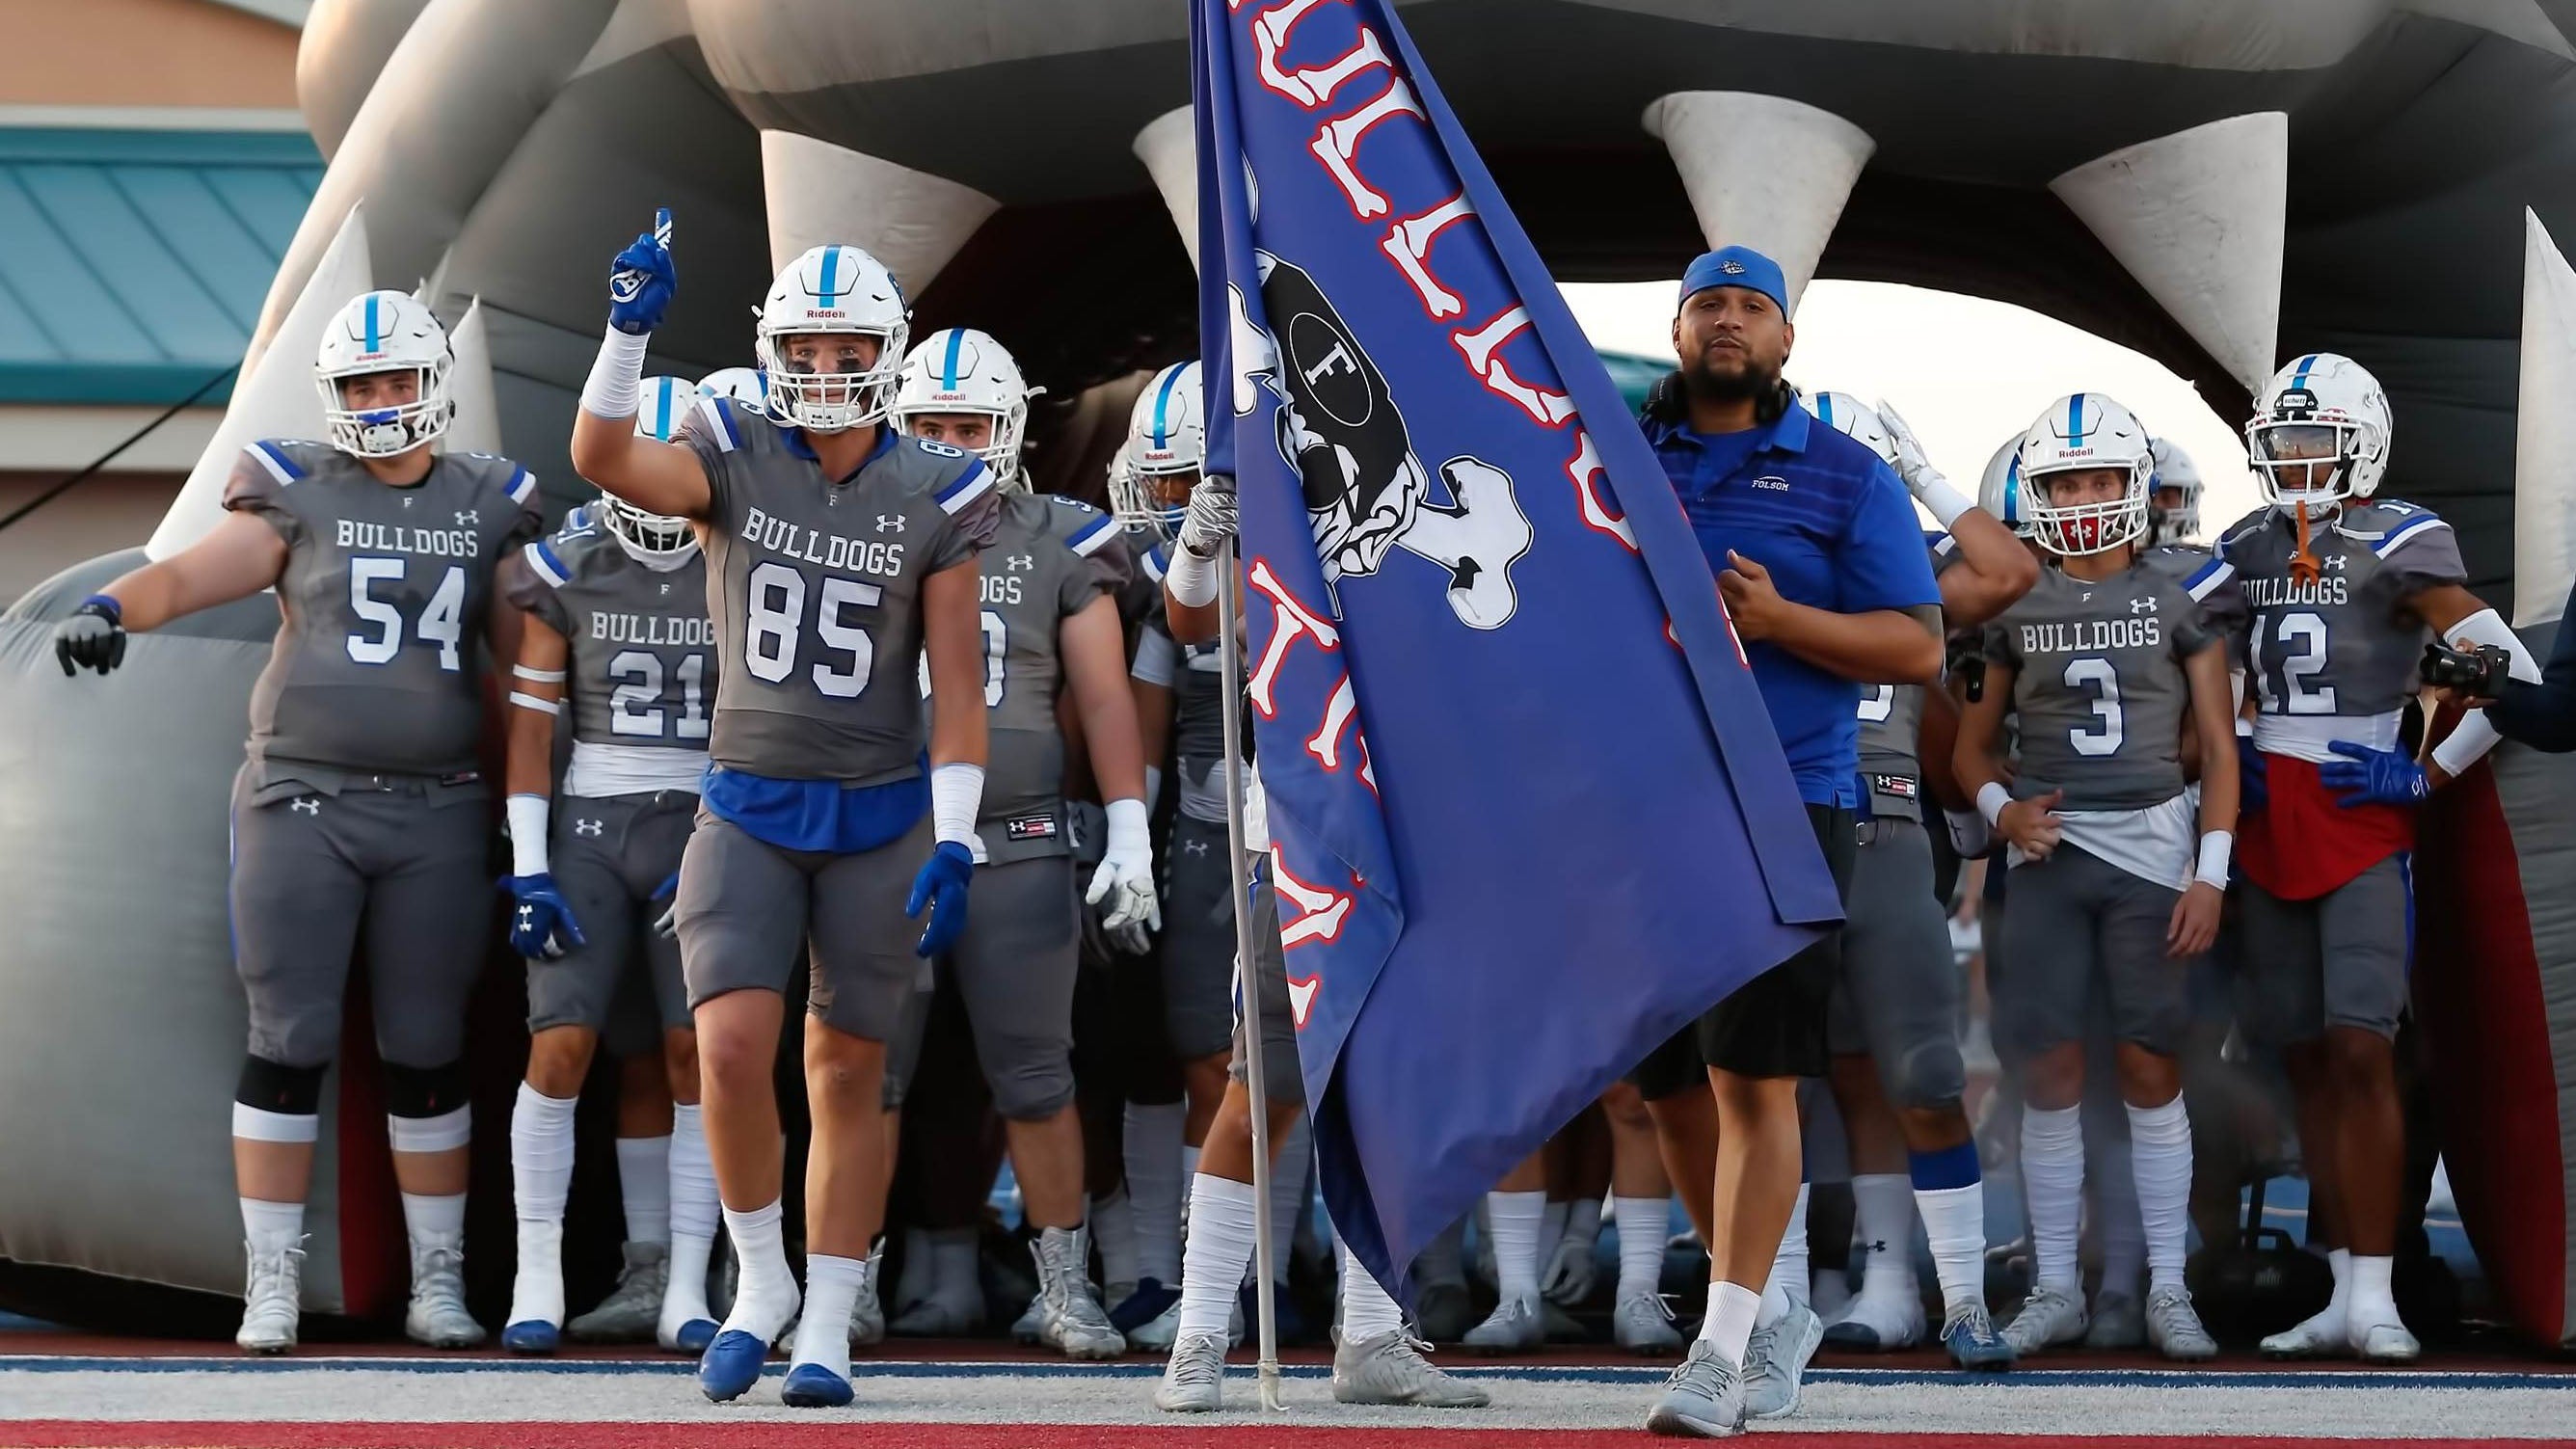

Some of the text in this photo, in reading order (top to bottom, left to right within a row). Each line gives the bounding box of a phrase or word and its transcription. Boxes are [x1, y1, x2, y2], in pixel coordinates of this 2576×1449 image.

[1304, 340, 1356, 389] F
[2058, 448, 2094, 459] Riddell
[404, 497, 414, 509] F
[829, 495, 838, 506] F
[1752, 479, 1789, 492] FOLSOM
[336, 519, 479, 557] BULLDOGS
[741, 506, 904, 577] BULLDOGS
[660, 583, 671, 595] F
[2082, 592, 2092, 603] F
[344, 556, 468, 672] 54
[591, 610, 716, 646] BULLDOG
[744, 561, 883, 698] 85
[2020, 617, 2160, 653] BULLDOGS
[2249, 613, 2338, 714] 12
[609, 650, 710, 739] 21
[2063, 657, 2124, 758] 3
